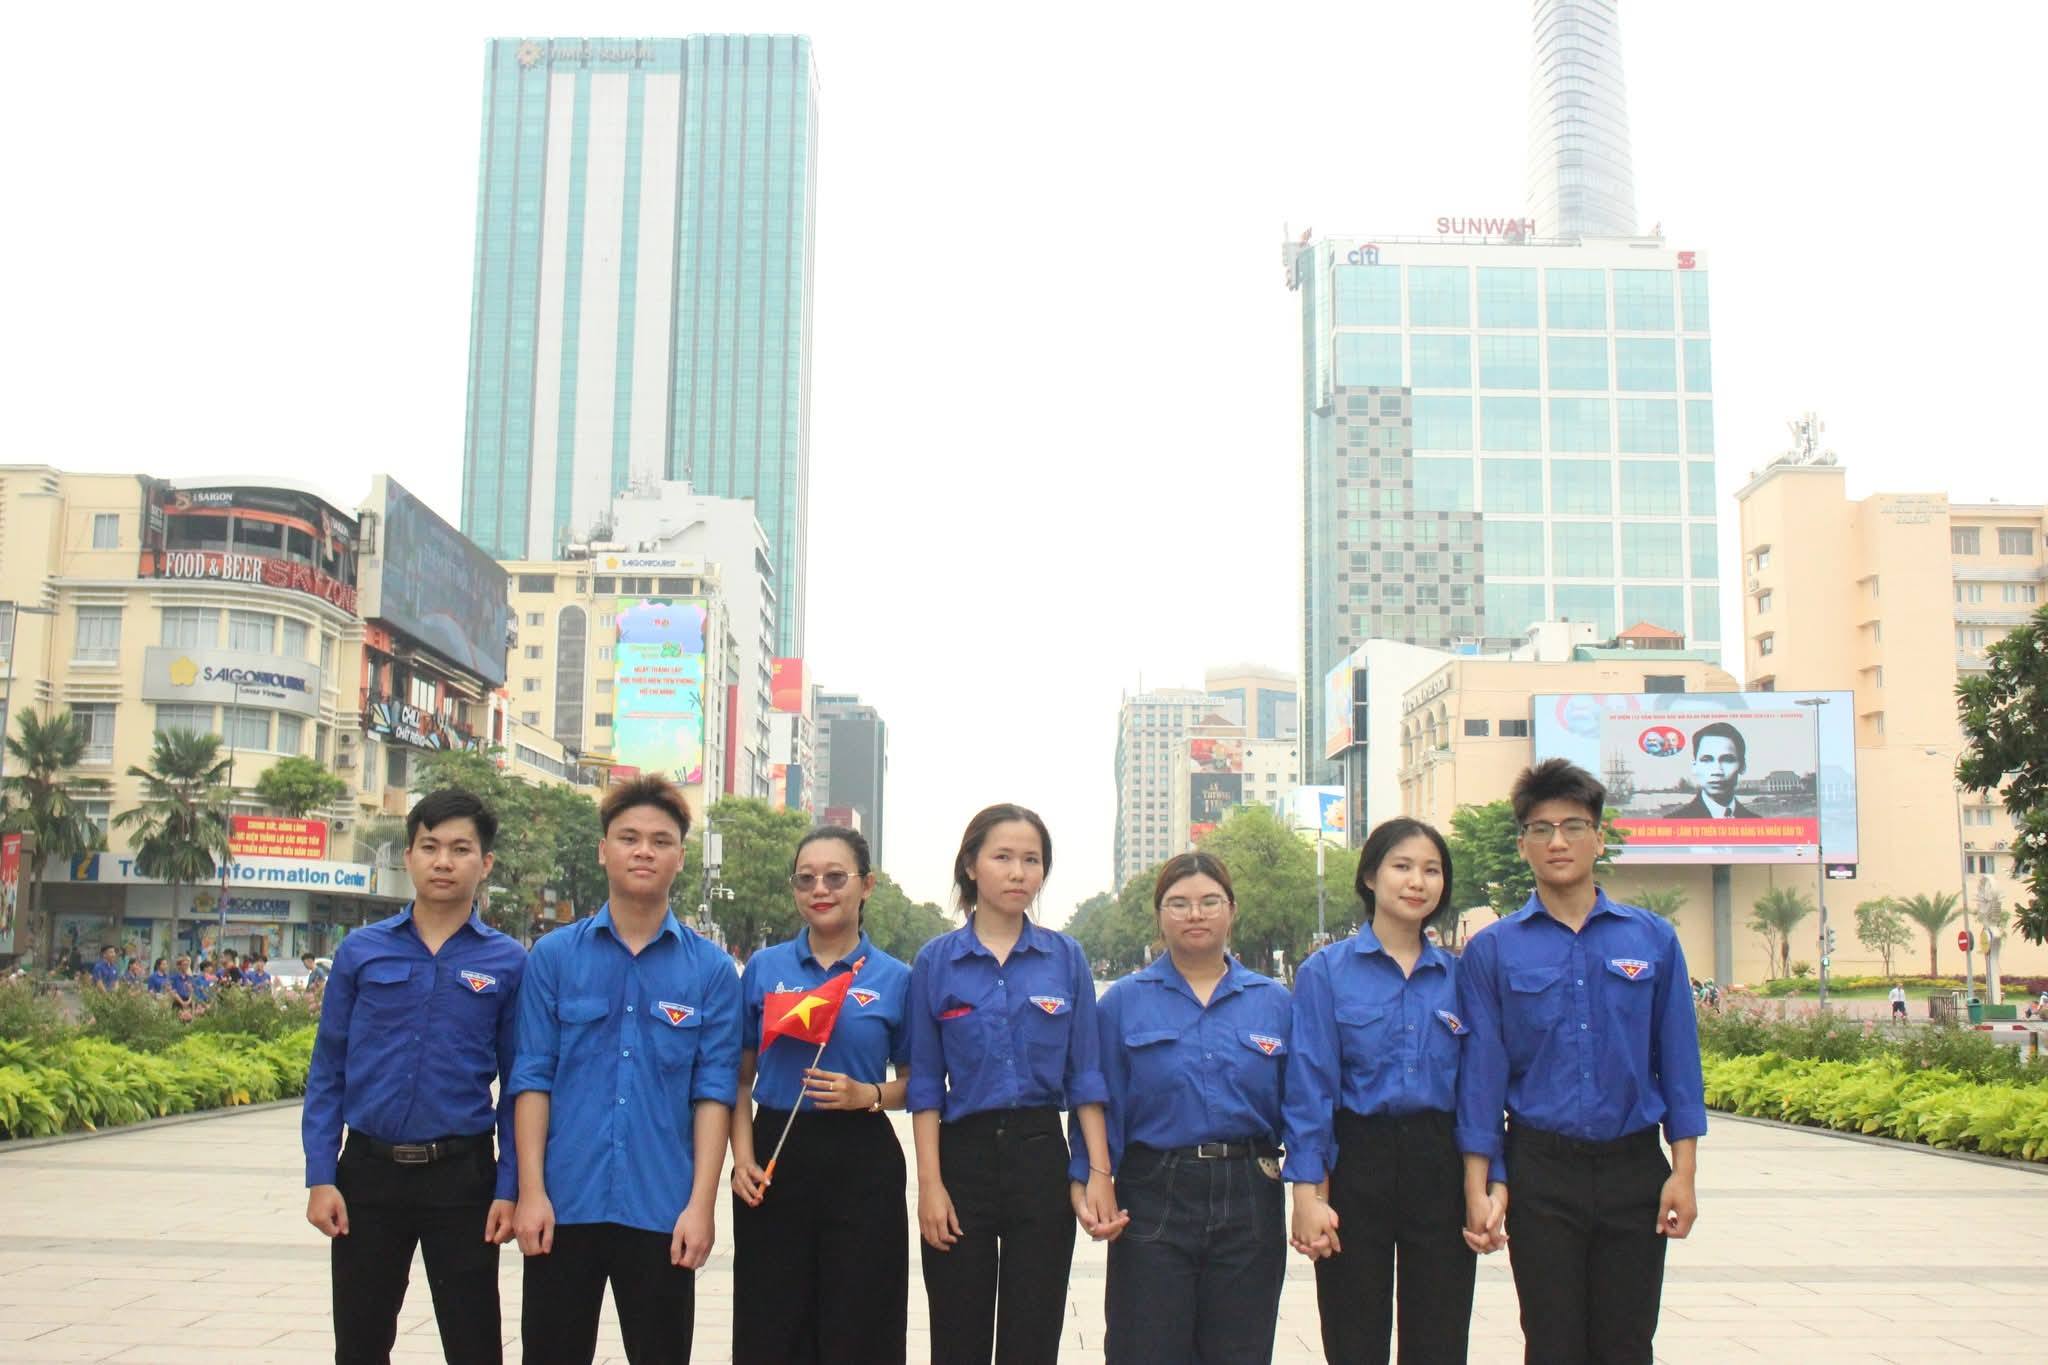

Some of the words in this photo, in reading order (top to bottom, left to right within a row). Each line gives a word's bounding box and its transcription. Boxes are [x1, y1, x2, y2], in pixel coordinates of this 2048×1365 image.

[1437, 216, 1536, 237] SUNWAH
[1348, 244, 1378, 265] citi
[165, 553, 205, 577] FOOD
[208, 558, 218, 576] &
[221, 555, 262, 583] BEER
[217, 863, 329, 884] nformation
